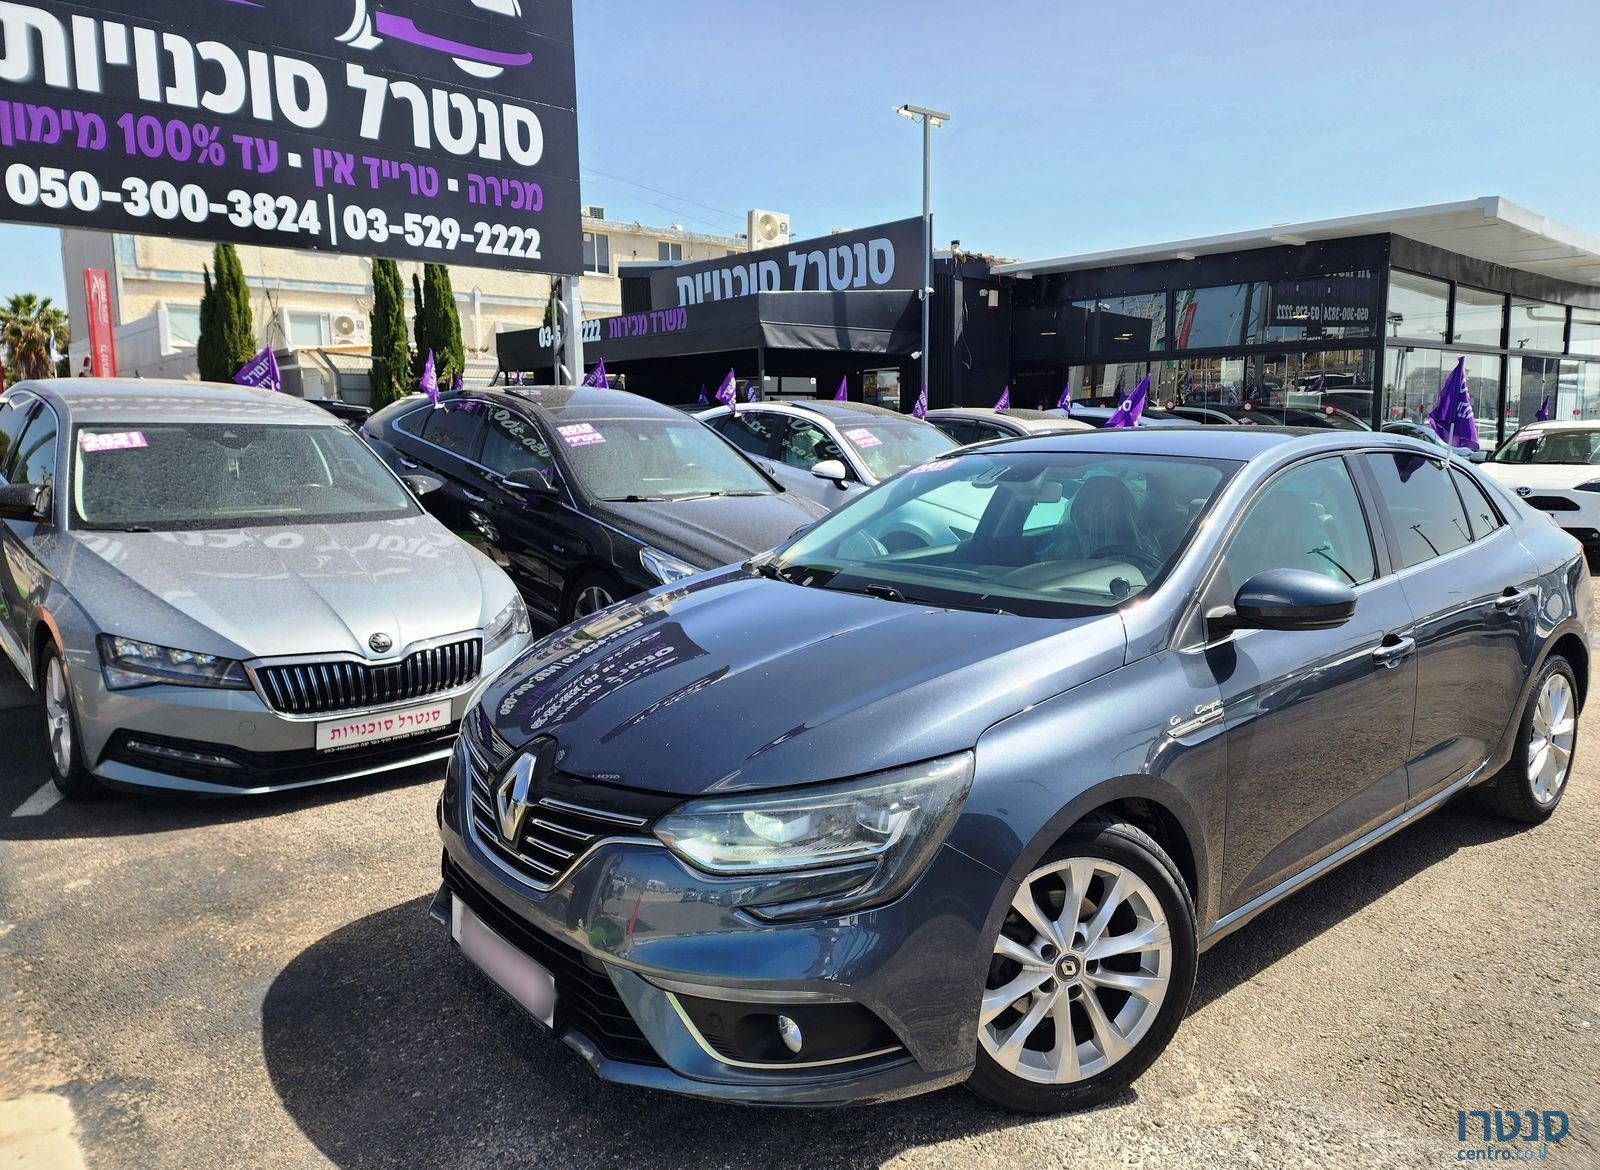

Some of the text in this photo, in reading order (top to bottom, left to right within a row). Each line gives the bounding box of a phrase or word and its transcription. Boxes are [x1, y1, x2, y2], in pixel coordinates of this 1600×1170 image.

[0, 7, 544, 167] סנטרל סוכנויות
[0, 100, 544, 213] מכירה טרייד אין עד 100% מימון
[5, 163, 541, 259] 050-300-3824 03-529-2222
[676, 238, 895, 306] סנטרל סוכנויות
[608, 308, 688, 338] משרד מכירות
[330, 719, 394, 740] סוכנויות
[398, 709, 441, 728] סנטרל
